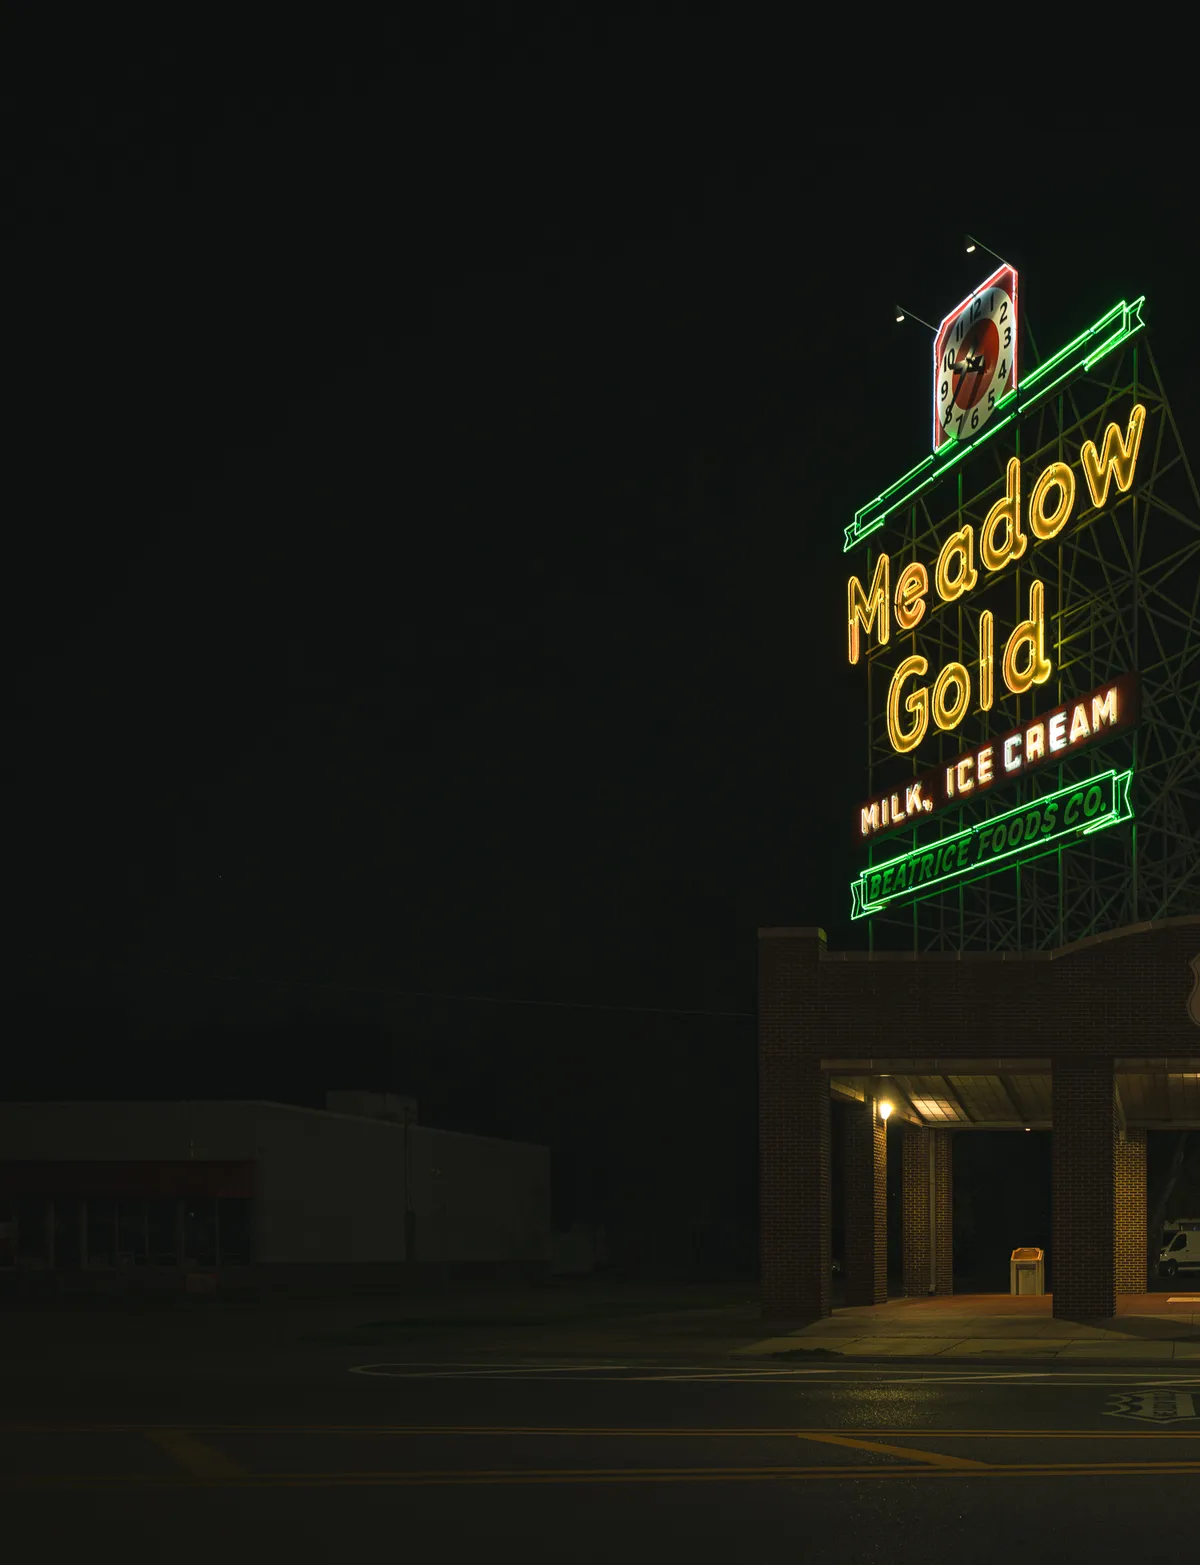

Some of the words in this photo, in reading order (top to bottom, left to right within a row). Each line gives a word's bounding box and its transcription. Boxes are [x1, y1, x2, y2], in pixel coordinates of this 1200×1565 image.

[970, 298, 982, 324] 12
[1000, 301, 1008, 324] 2
[956, 320, 964, 342] 11
[1003, 327, 1011, 349] 3
[943, 348, 955, 373] 10
[998, 359, 1007, 379] 4
[941, 381, 949, 402] 9
[988, 388, 995, 411] 5
[945, 405, 953, 424] 8
[956, 414, 963, 437] 7
[970, 408, 979, 430] 6
[847, 403, 1146, 664] Meadow
[886, 579, 1051, 753] Gold
[860, 781, 934, 836] MILK,
[946, 746, 995, 798] ICE
[1004, 686, 1118, 772] CREAM
[870, 837, 971, 900] BEATRICE
[977, 802, 1059, 860] FOODS
[1063, 785, 1107, 824] CO.
